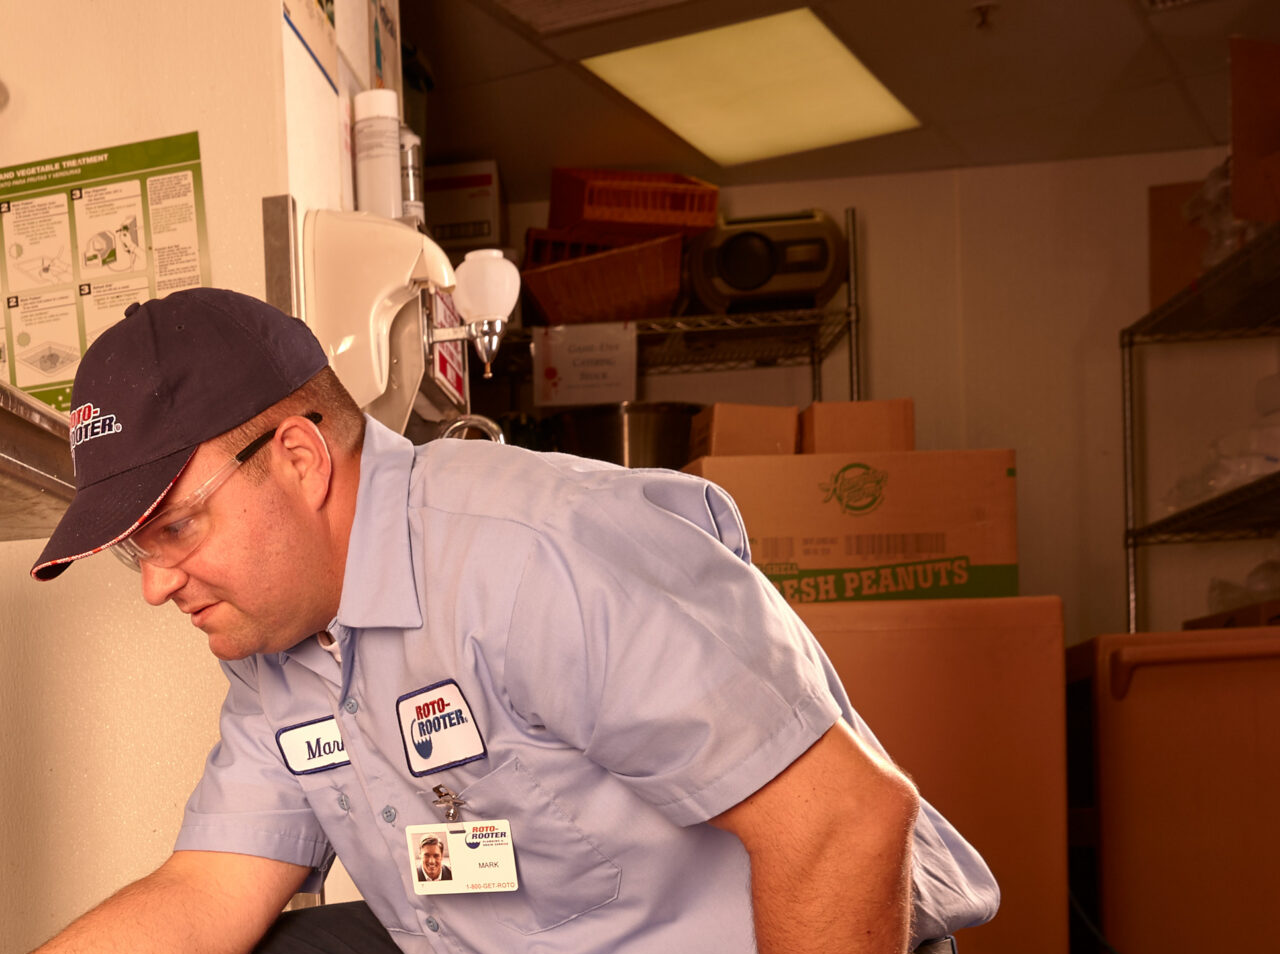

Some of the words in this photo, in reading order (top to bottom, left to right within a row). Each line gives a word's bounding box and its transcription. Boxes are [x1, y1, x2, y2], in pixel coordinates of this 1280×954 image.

[17, 162, 60, 178] VEGETABLE
[62, 153, 109, 169] TREATMENT
[70, 403, 100, 429] OTO-
[775, 572, 838, 602] ESH
[842, 559, 969, 599] PEANUTS
[415, 697, 451, 720] ROTO-
[418, 708, 466, 738] ROOTER
[305, 737, 345, 761] Mar
[471, 831, 507, 840] ROOTER
[472, 825, 499, 833] ROTO-
[478, 861, 499, 869] MARK
